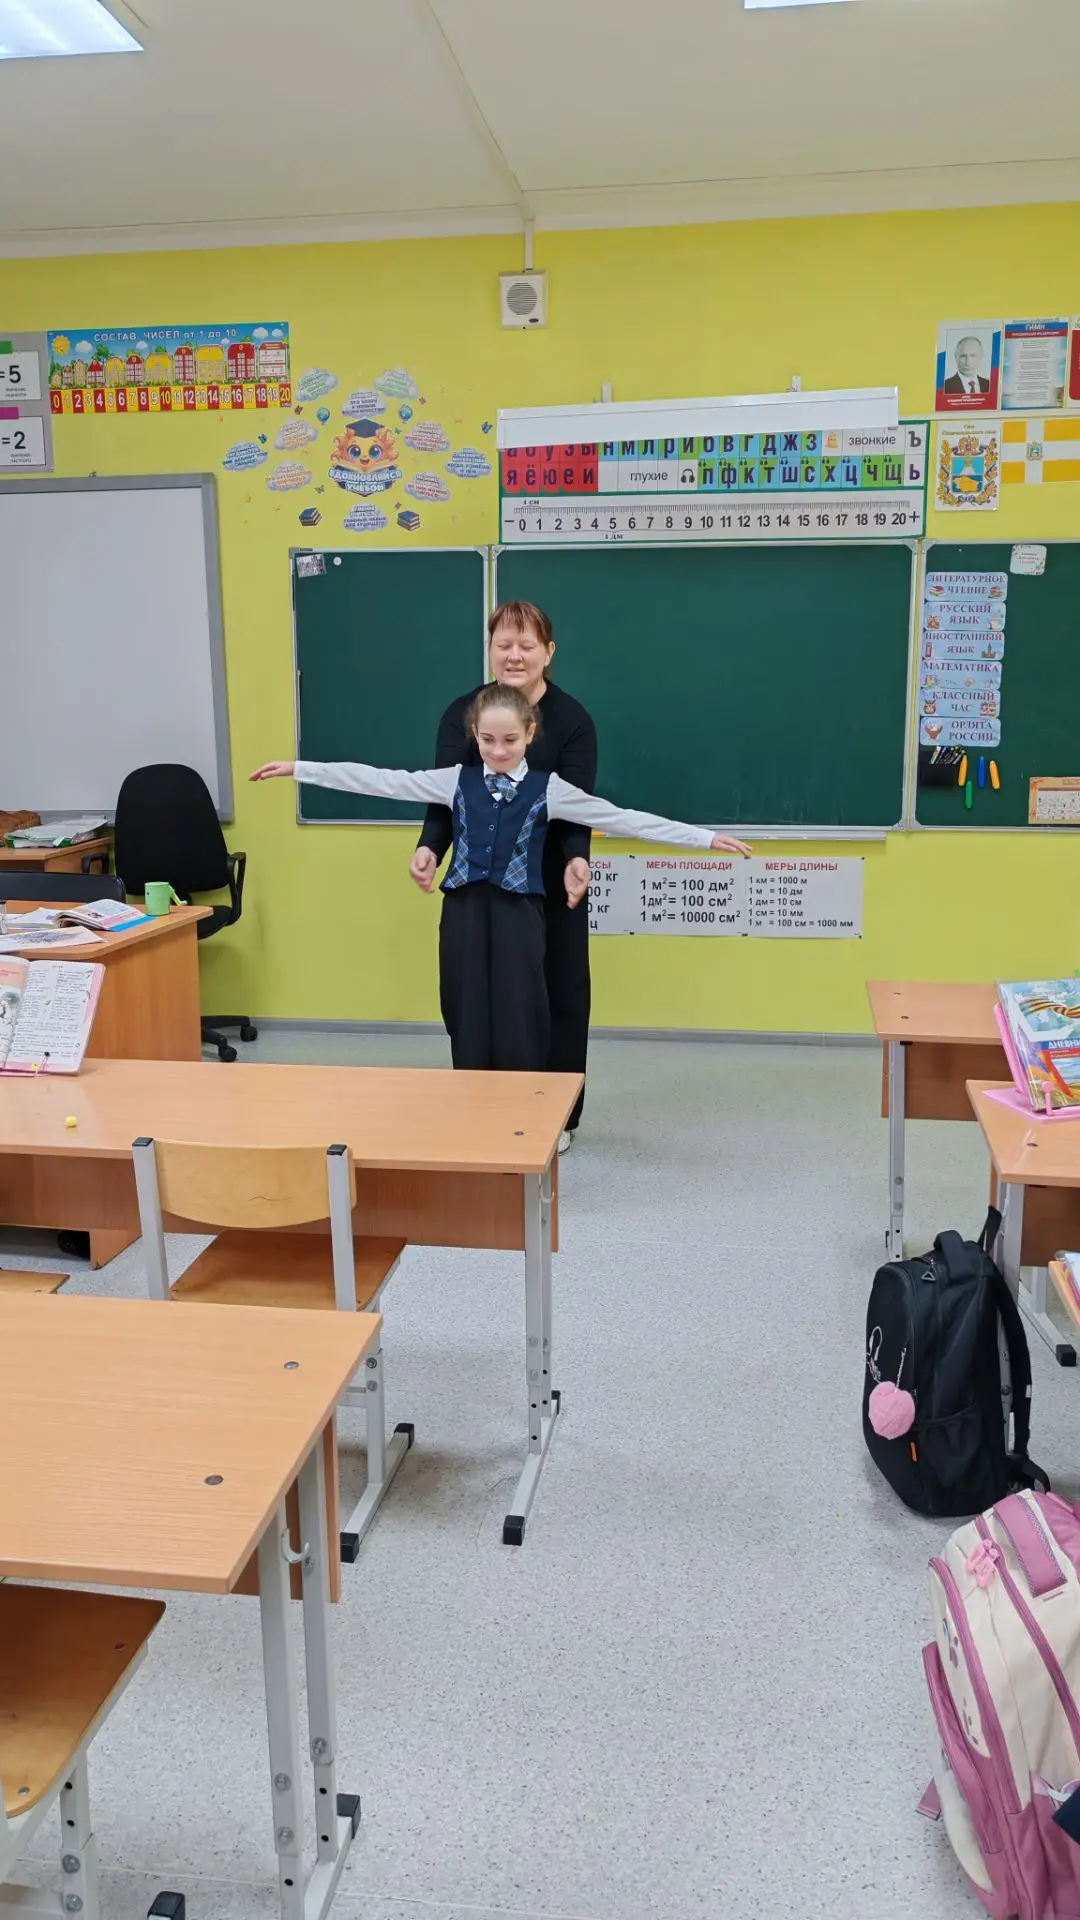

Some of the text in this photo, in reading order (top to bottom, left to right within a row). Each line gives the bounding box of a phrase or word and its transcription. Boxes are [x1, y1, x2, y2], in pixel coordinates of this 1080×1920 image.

[94, 333, 137, 341] СОСТАВ
[143, 330, 180, 340] ЧИСЕЛ
[225, 329, 237, 337] 10
[53, 395, 59, 408] 0
[74, 394, 82, 408] 2
[86, 393, 92, 407] 3
[96, 393, 104, 407] 4
[118, 392, 125, 406] 6
[129, 392, 136, 407] 7
[140, 391, 147, 405] 8
[151, 391, 158, 405] 9
[160, 391, 170, 405] 10
[173, 391, 183, 404] 11
[184, 390, 194, 404] 12
[207, 389, 218, 403] 14
[220, 389, 229, 404] 15
[232, 389, 242, 402] 16
[244, 388, 253, 403] 17
[256, 388, 267, 402] 18
[268, 387, 278, 401] 19
[280, 387, 291, 401] 20
[848, 436, 896, 446] звонкие
[328, 468, 402, 481] ВДОХНОВЛЯЙСЯ
[630, 472, 668, 483] глухие
[519, 512, 906, 531] 0 1 2 3 4 5 6 7 8 9 10 11 12 13 14 15 16 17 18 19 20
[928, 575, 1006, 583] ЛИТЕРАТУРНОЕ
[948, 586, 988, 594] ЧТЕНИЕ
[940, 603, 991, 613] РУССКИЙ
[949, 616, 980, 624] ЯЗЫК
[925, 632, 1002, 641] ИНОСТРАННЫЙ
[947, 645, 975, 653] ЯЗЫК
[924, 662, 999, 672] МАТЕМАТИКА
[932, 690, 994, 701] КЛАССНЫЙ
[951, 704, 973, 712] ЧАС
[951, 720, 993, 730] ОРЛЯТА
[949, 732, 993, 741] РОССИИ
[646, 861, 732, 871] МЕРЫ ПЛОЩАДИ
[765, 863, 838, 872] МЕРЫ ДЛИНЫ
[606, 873, 619, 881] кг
[749, 876, 753, 884] 1
[778, 876, 798, 884] 1000
[640, 879, 646, 890] 1
[681, 879, 704, 891] 100
[606, 888, 611, 897] г
[749, 887, 753, 895] 1
[778, 887, 788, 895] 10
[681, 895, 704, 907] 100
[777, 898, 788, 906] 10
[597, 904, 610, 913] кг
[777, 909, 787, 917] 10
[640, 910, 646, 922] 1
[680, 911, 715, 923] 10000
[590, 920, 598, 930] ц
[748, 919, 752, 927] 1
[777, 919, 792, 927] 100
